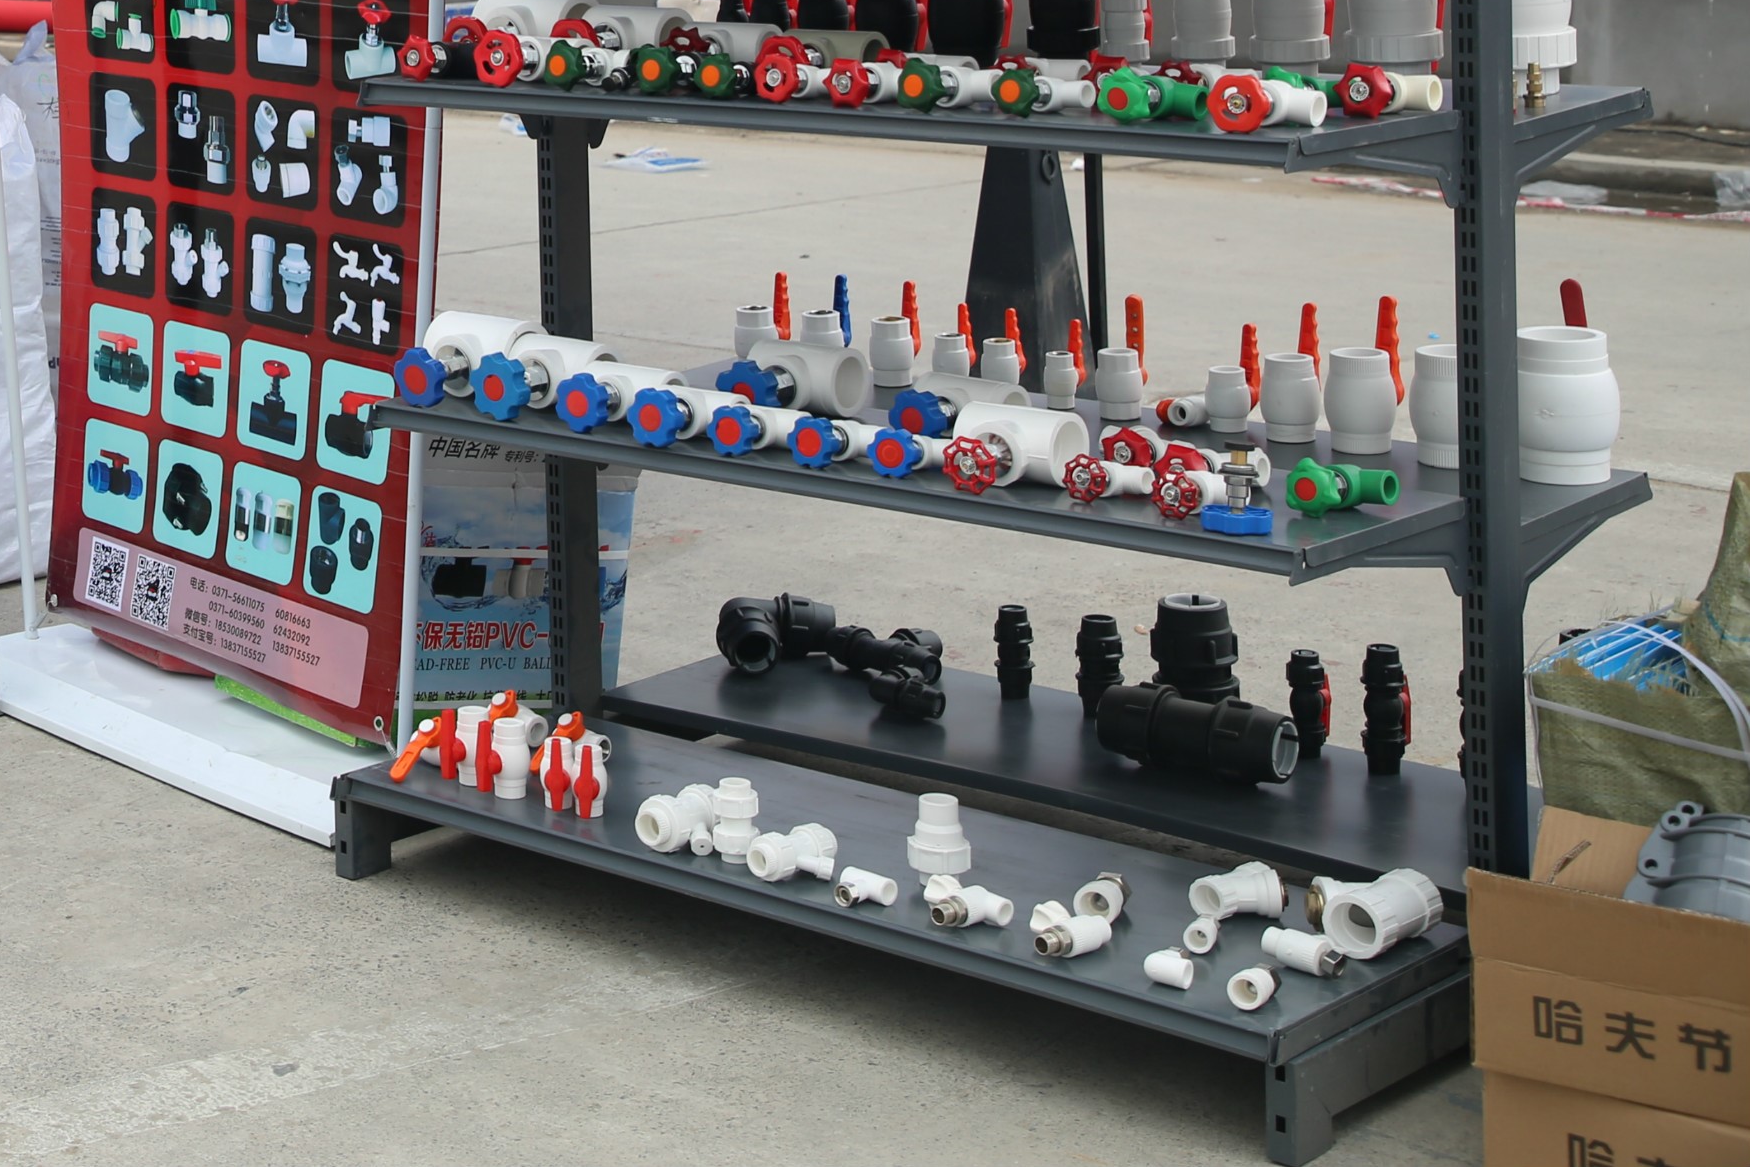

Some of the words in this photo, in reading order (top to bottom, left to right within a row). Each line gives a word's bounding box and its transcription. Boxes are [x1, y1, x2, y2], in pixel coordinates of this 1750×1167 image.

[428, 436, 501, 460] 中国名牌
[209, 600, 265, 630] 0371-60399560
[273, 624, 310, 647] 62432092
[275, 608, 311, 629] 60816663
[415, 621, 550, 651] 保无铅PVC-
[272, 640, 320, 667] 13837155527
[480, 657, 517, 671] PVC-U
[1532, 996, 1732, 1074] 哈夫节
